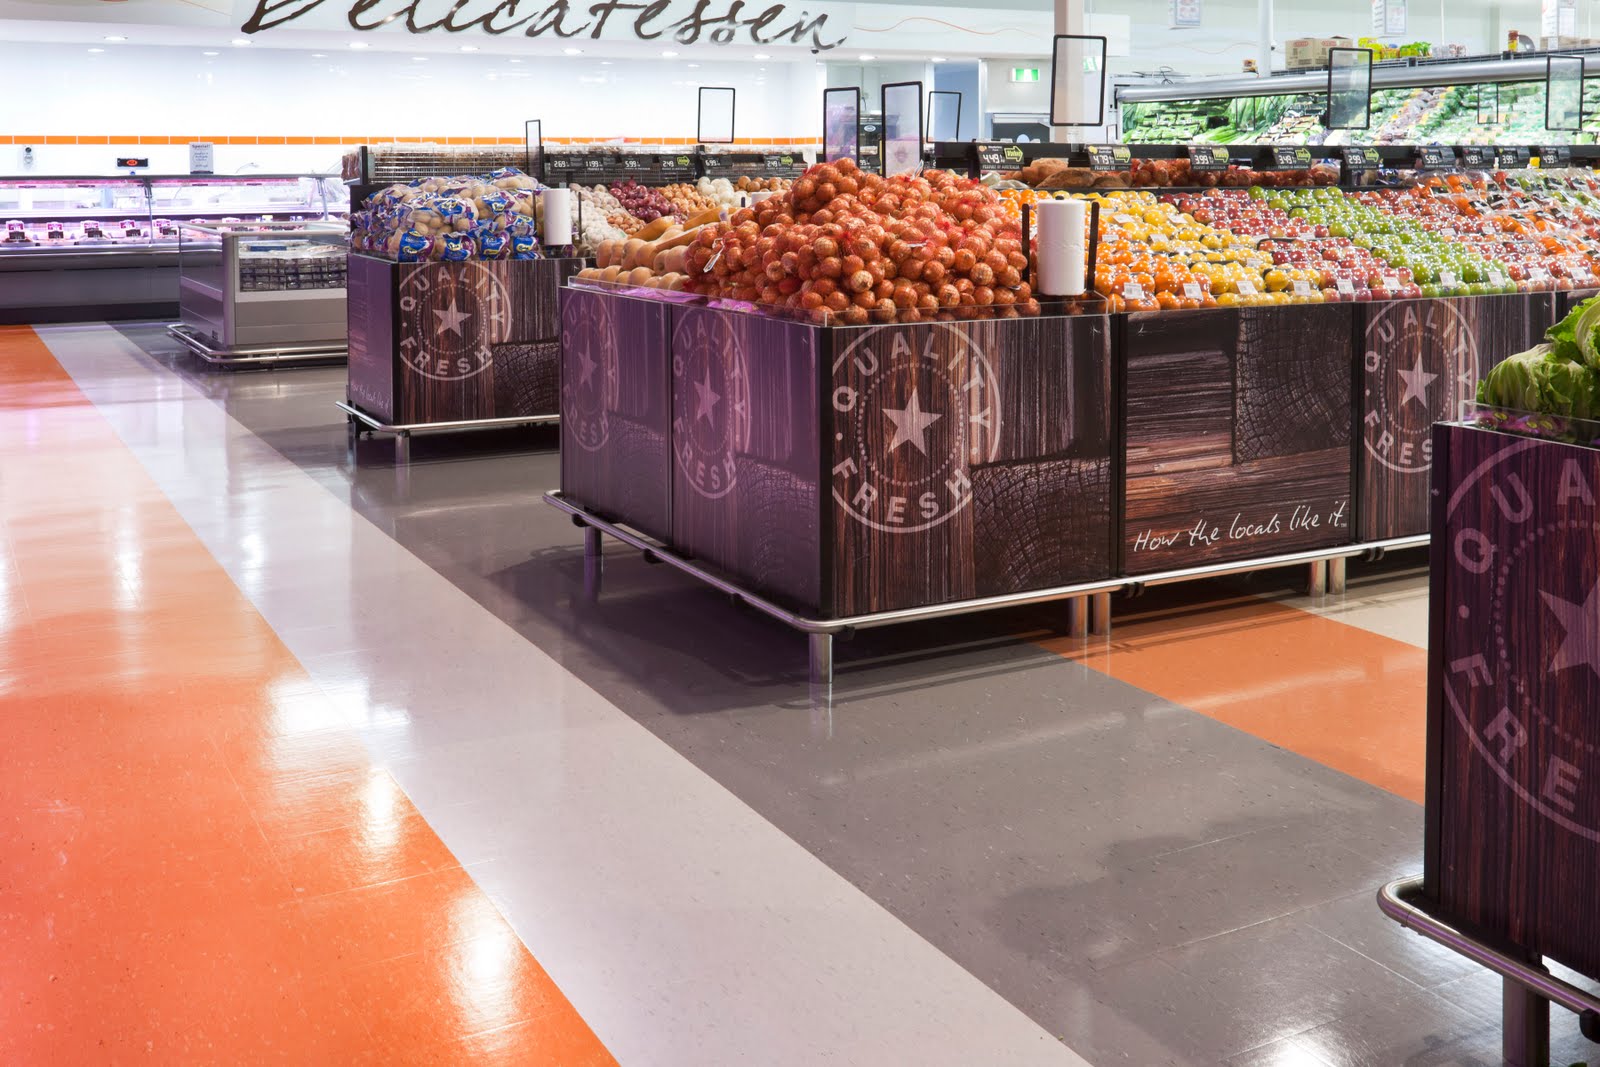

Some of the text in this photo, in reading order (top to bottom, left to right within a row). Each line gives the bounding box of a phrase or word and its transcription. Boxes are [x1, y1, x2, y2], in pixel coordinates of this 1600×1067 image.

[400, 266, 505, 324] QUALITY
[400, 336, 493, 375] FRESH
[562, 295, 616, 383] QUALITY
[673, 314, 745, 418] QUALITY
[1364, 306, 1473, 387] QUALITY
[832, 332, 991, 429] QUALITY
[673, 416, 737, 490] FRESH
[1364, 410, 1433, 465] FRES
[832, 457, 972, 523] FRESH
[1134, 529, 1179, 551] How
[1189, 519, 1220, 547] the
[1229, 513, 1281, 539] locals
[1289, 505, 1320, 531] like
[1454, 458, 1597, 575] QUA
[1451, 654, 1582, 813] FRE
